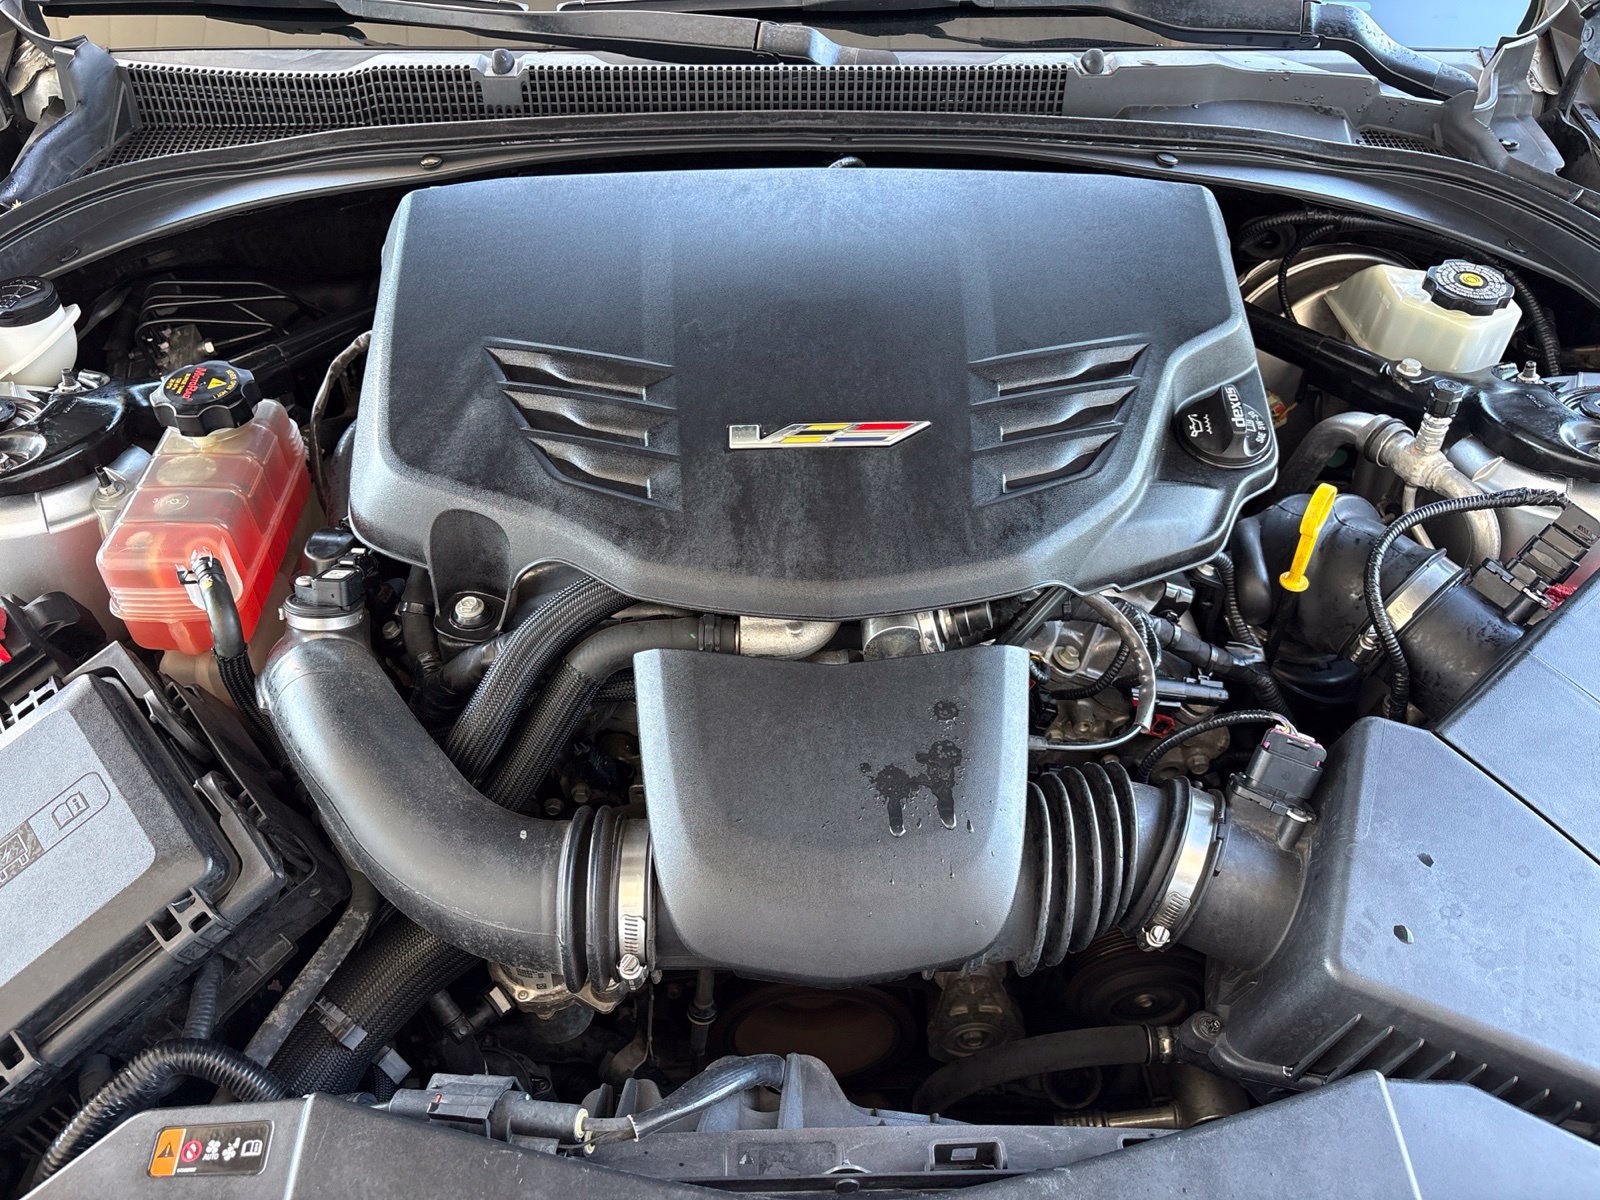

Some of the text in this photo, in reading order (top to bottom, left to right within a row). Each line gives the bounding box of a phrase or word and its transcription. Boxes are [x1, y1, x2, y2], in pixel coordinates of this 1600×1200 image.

[1224, 386, 1246, 428] dexos
[1247, 410, 1266, 443] SAE 5W-30
[202, 1153, 219, 1161] AUTO
